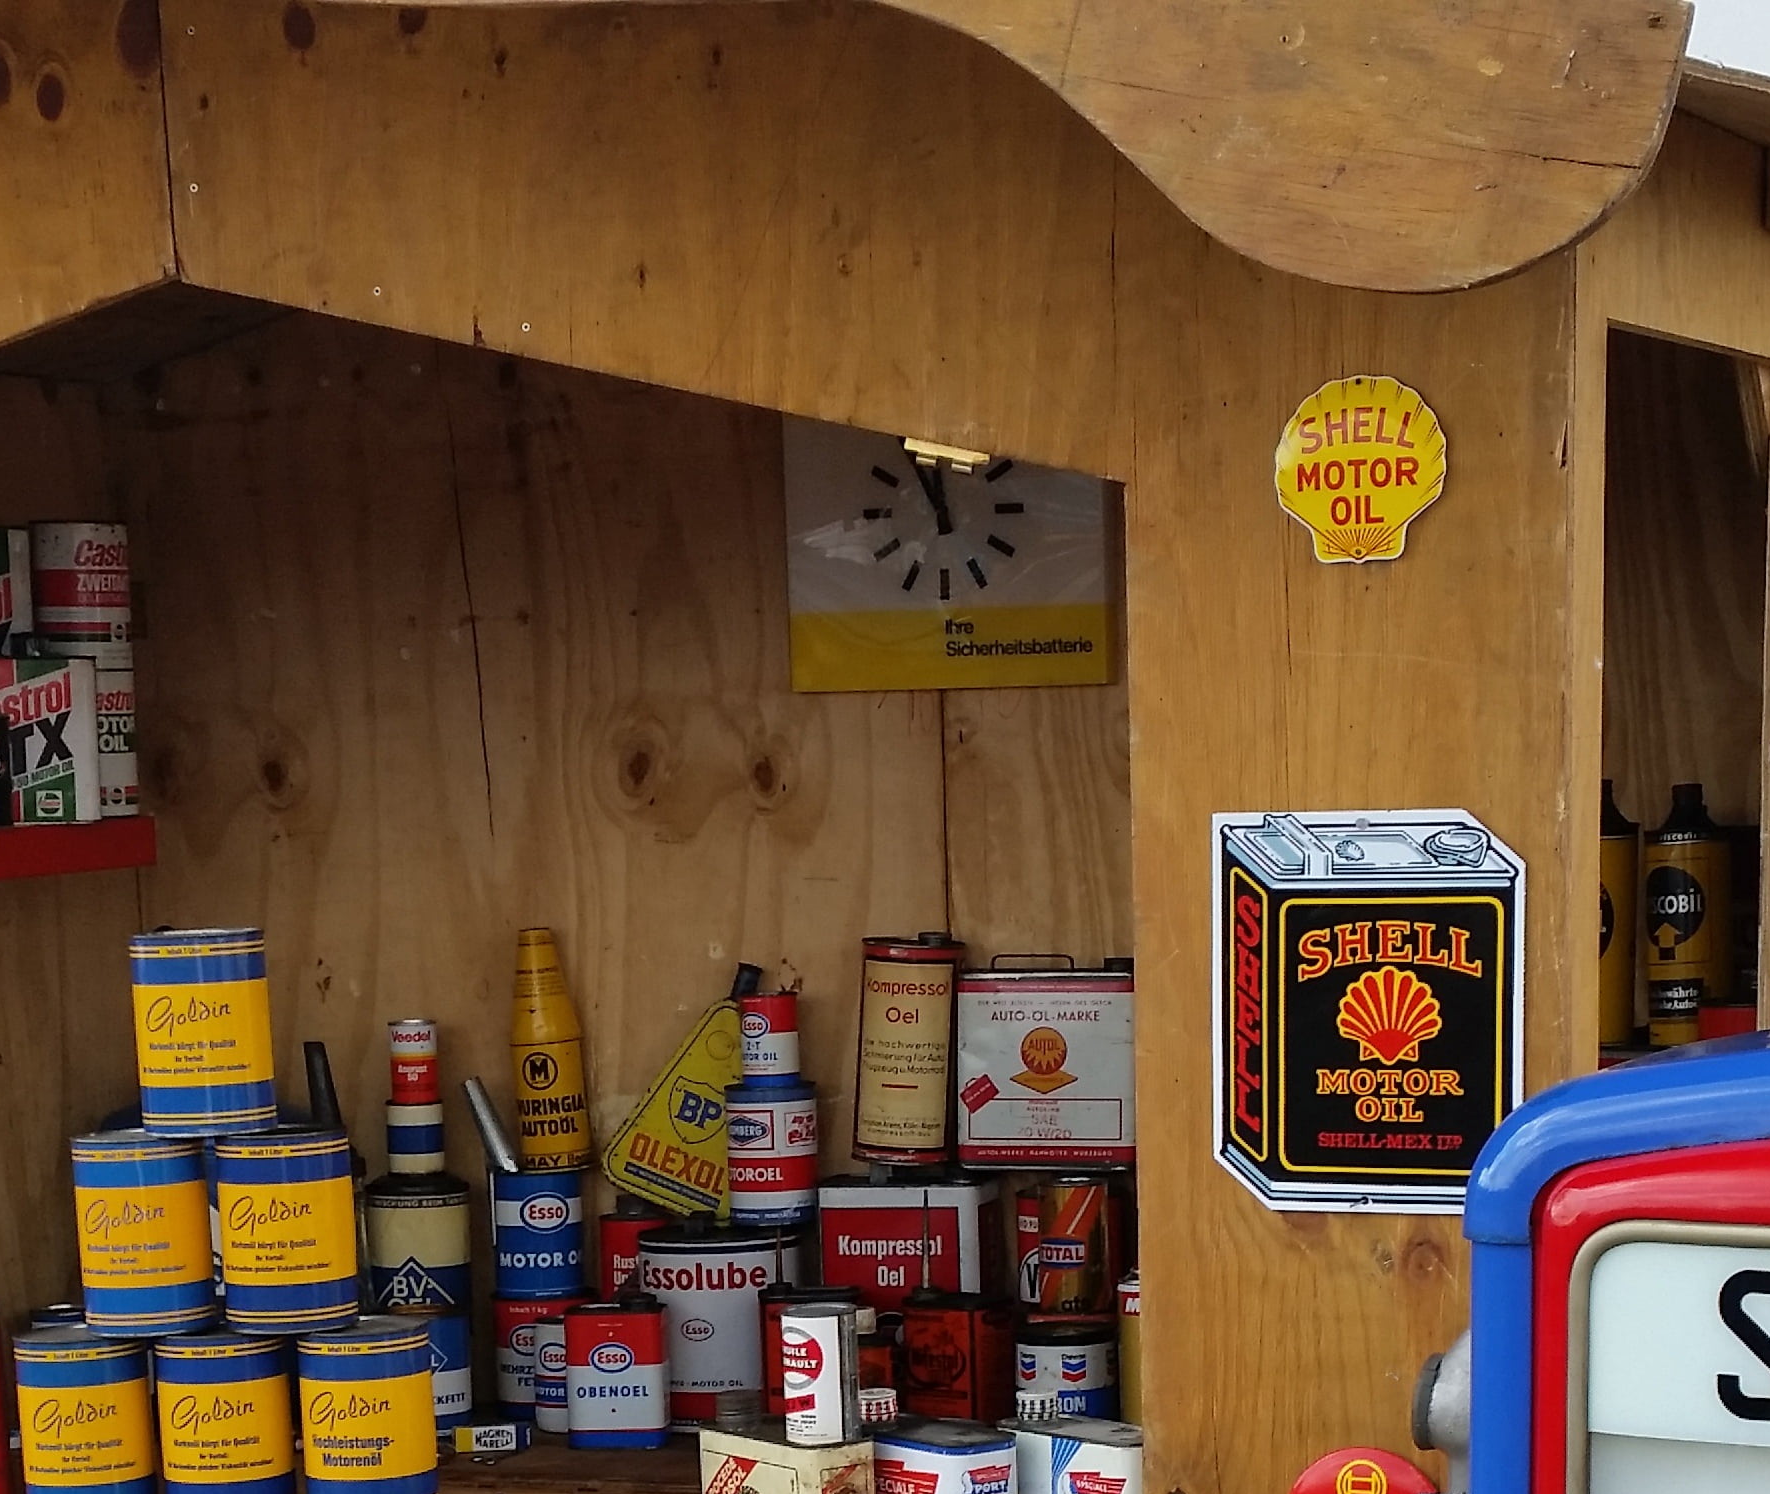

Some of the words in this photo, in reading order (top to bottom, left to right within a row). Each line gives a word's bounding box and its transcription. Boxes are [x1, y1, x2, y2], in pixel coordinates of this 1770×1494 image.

[1299, 406, 1415, 454] SHELL
[1297, 457, 1420, 492] MOTOR
[1331, 495, 1384, 526] OIL
[944, 618, 974, 635] Ihre
[945, 636, 1093, 657] Sicherheitsbatterie
[1298, 920, 1482, 983] SHELL
[885, 1007, 919, 1025] Oel
[1236, 894, 1261, 1133] SHELL
[763, 1052, 778, 1061] OIL
[1316, 1068, 1464, 1096] MOTOR
[674, 1089, 723, 1130] BP
[1355, 1096, 1424, 1123] OIL
[1318, 1132, 1433, 1149] SHELL-MEX
[499, 1253, 565, 1269] MOTOR
[643, 1259, 768, 1291] Essolube
[877, 1266, 905, 1287] Oel
[577, 1385, 649, 1399] OBENOEL
